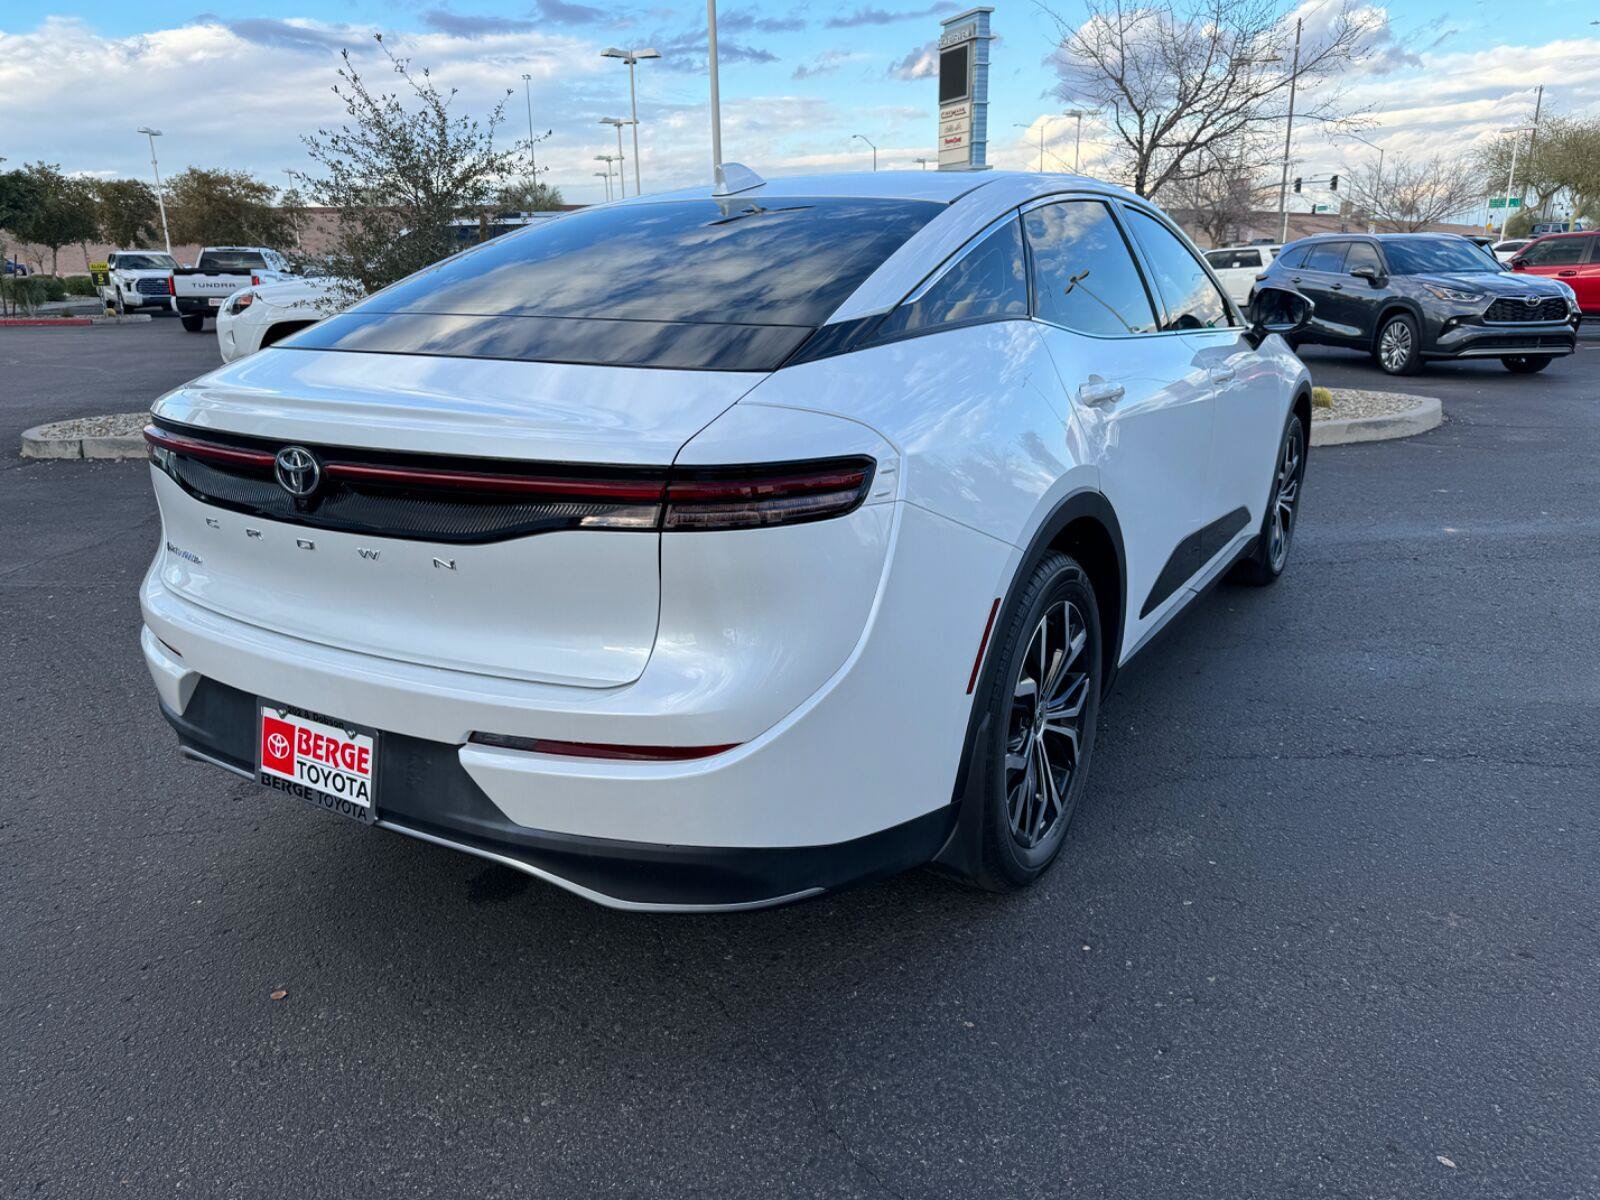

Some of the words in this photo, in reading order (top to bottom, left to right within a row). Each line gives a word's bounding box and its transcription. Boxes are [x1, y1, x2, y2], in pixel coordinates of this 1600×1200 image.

[205, 516, 457, 571] CROWN
[297, 726, 370, 775] BERGE
[260, 771, 314, 801] BERGE
[316, 790, 368, 820] TOYOTA
[296, 760, 370, 802] TOYOTA
